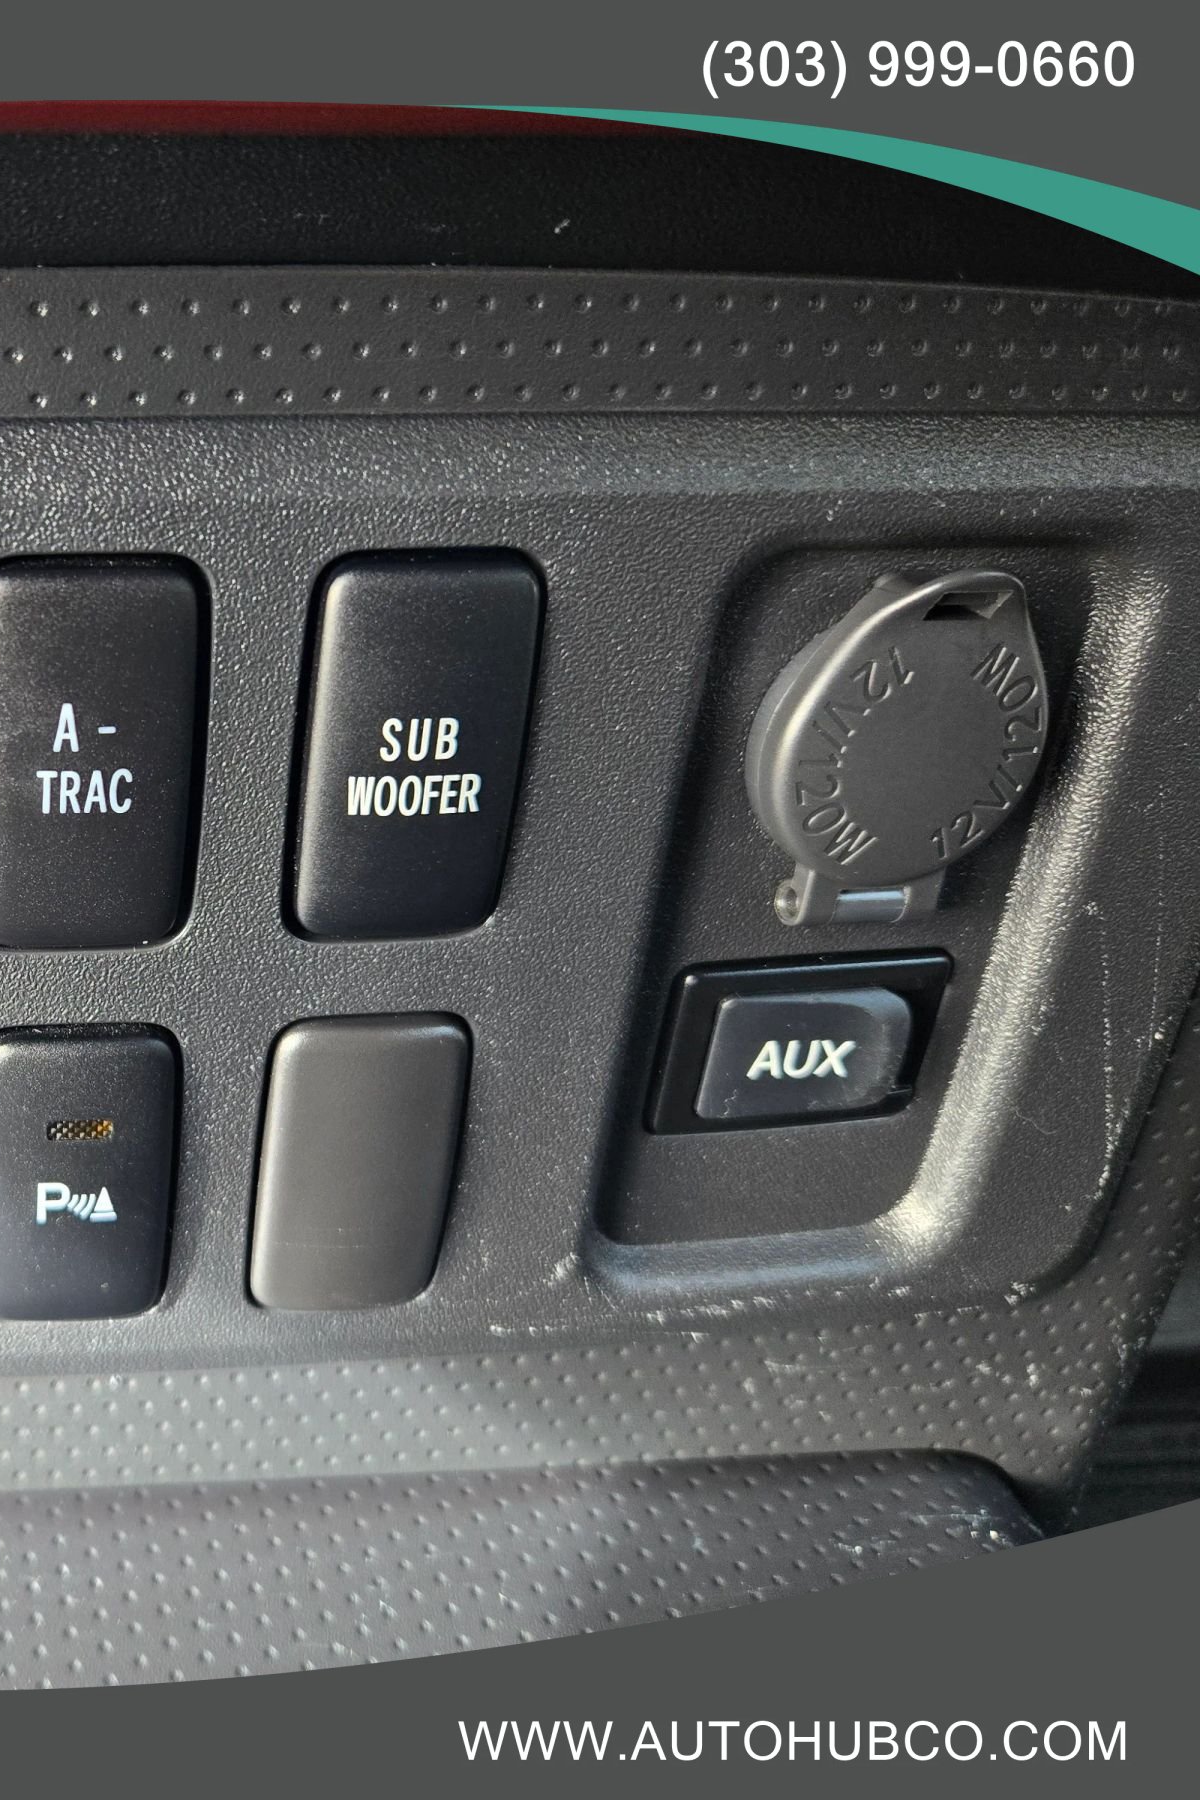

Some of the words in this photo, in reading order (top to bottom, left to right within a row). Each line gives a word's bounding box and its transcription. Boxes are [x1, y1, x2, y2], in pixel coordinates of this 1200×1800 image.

[379, 716, 460, 762] SUB
[36, 768, 133, 814] TRAC
[346, 772, 482, 817] WOOFER
[746, 1039, 857, 1081] AUX
